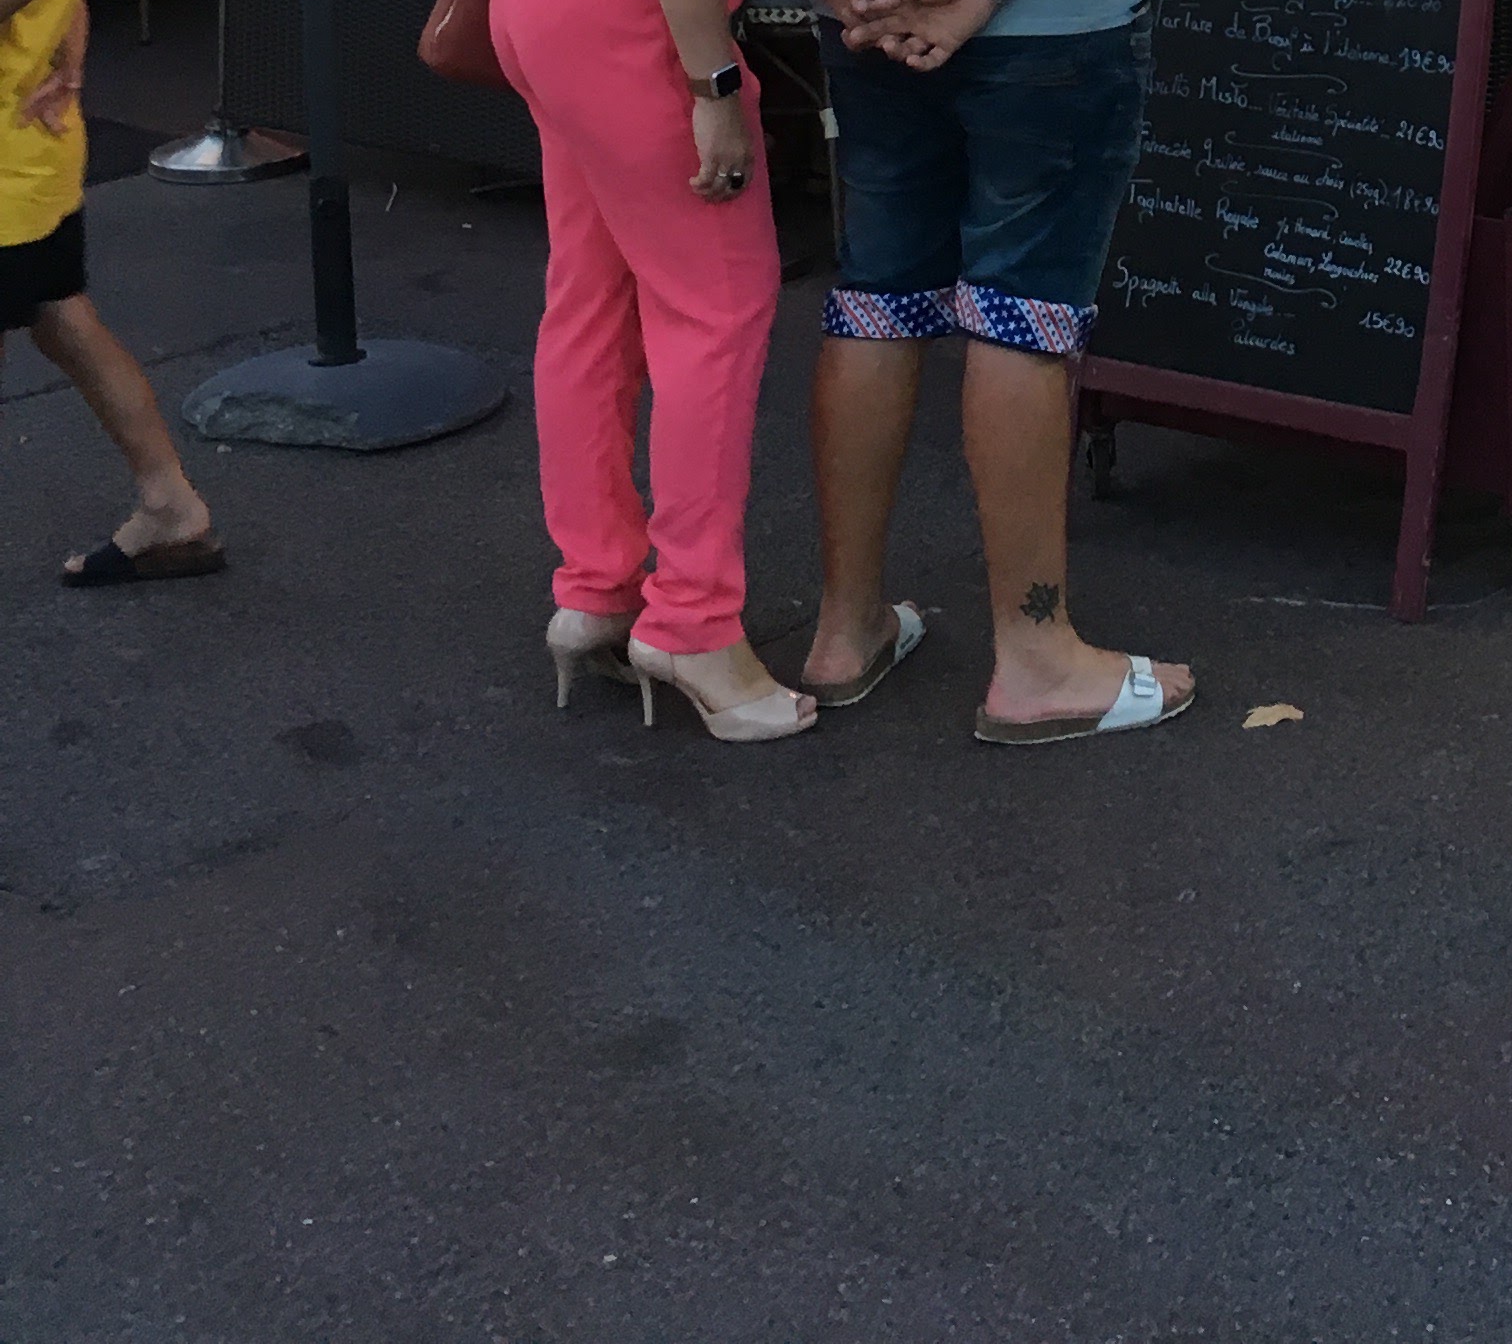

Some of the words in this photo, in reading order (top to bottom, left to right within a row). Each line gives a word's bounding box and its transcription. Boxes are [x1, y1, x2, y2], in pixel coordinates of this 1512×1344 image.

[1224, 11, 1247, 39] de
[1198, 75, 1249, 108] Misto
[1358, 310, 1416, 339] 15€90
